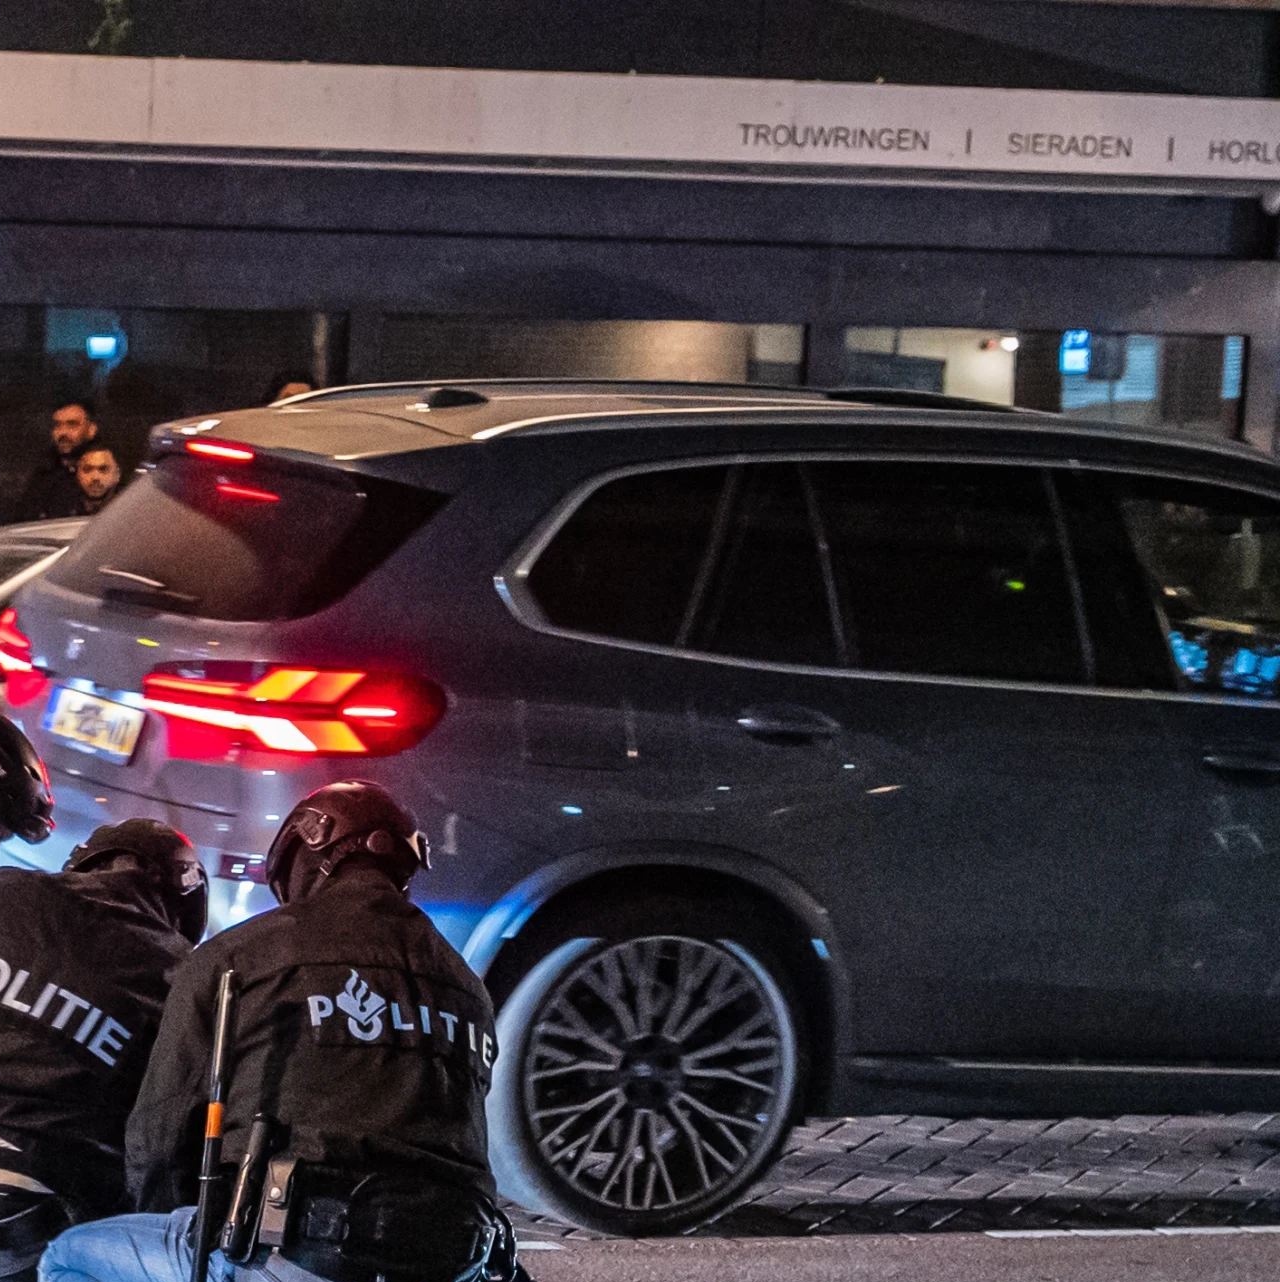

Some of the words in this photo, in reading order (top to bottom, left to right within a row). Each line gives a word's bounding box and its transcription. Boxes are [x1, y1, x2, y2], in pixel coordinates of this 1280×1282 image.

[739, 123, 930, 151] TROUWRINGEN
[1007, 132, 1133, 159] SIERADEN
[1208, 139, 1280, 165] HORL
